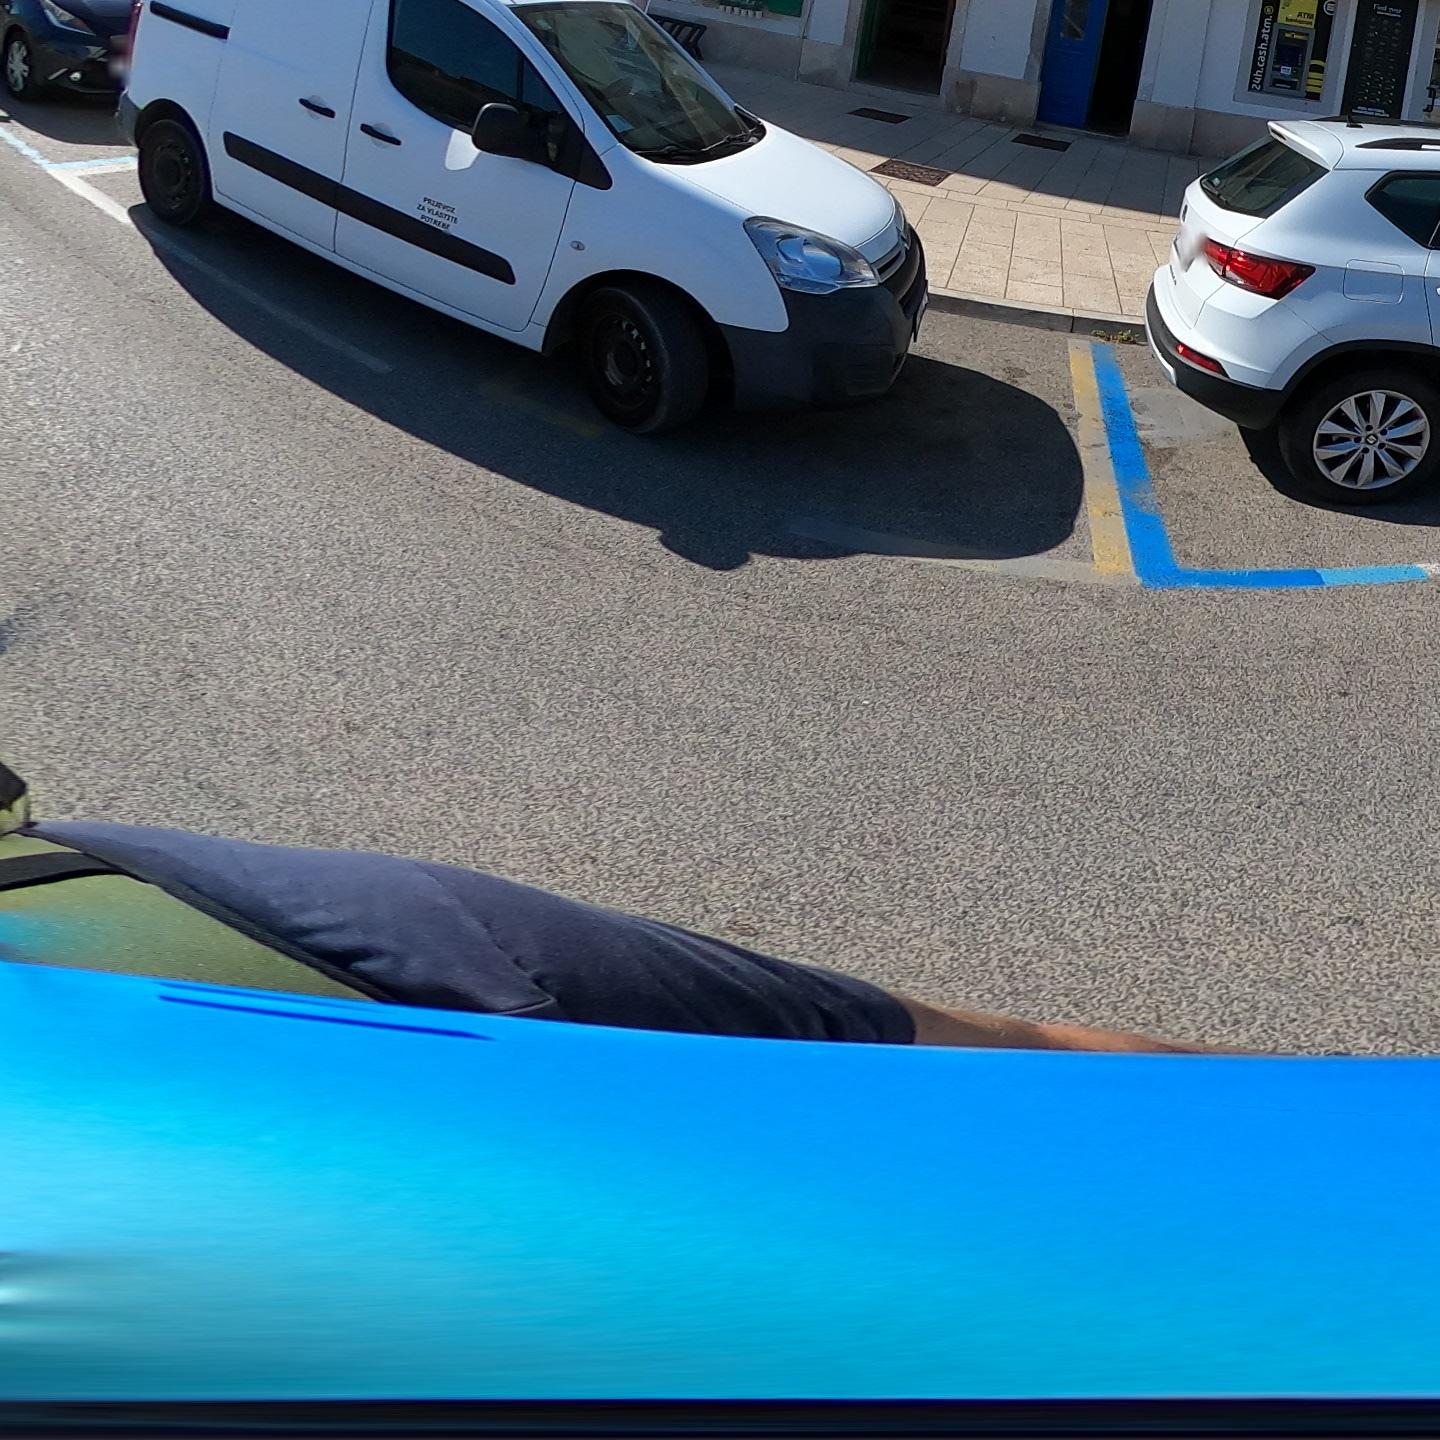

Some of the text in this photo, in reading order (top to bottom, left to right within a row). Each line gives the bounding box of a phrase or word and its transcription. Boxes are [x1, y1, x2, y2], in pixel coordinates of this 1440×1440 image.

[1297, 11, 1314, 19] ATM
[416, 203, 458, 224] ZA VLASTITE
